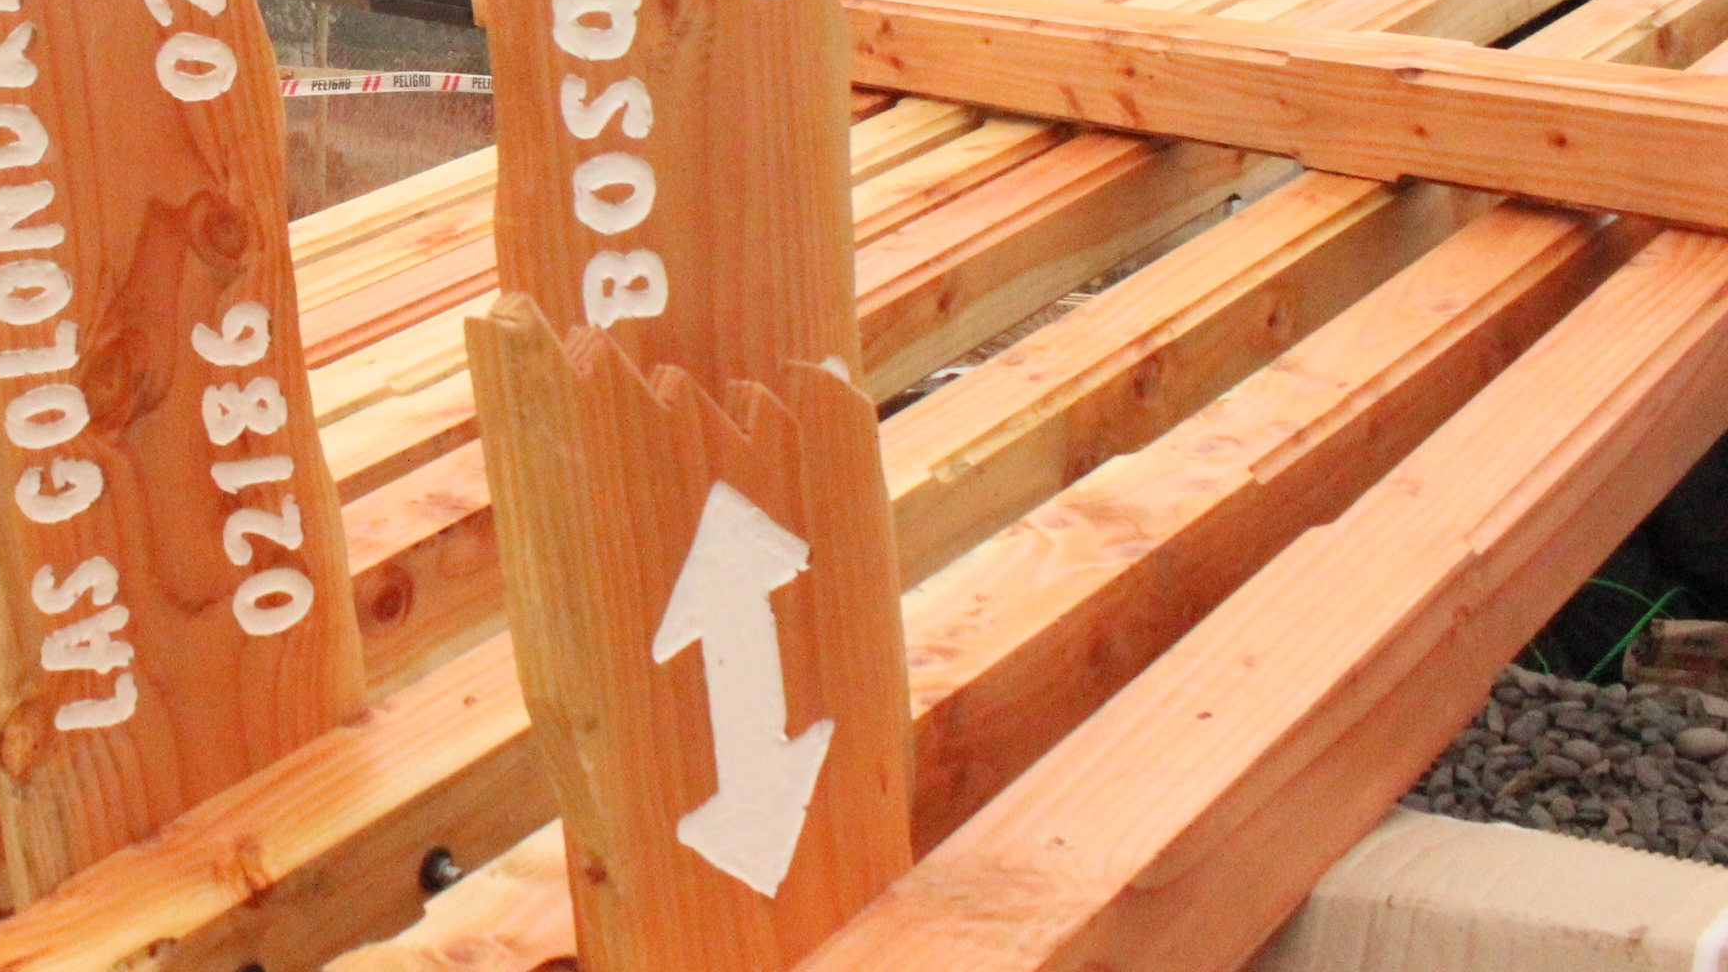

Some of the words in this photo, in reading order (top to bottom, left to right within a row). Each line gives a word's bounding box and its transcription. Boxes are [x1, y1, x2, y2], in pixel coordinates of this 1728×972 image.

[311, 78, 352, 92] PELIGRO
[393, 74, 431, 89] PELIGRO
[190, 300, 315, 637] 02186
[30, 555, 138, 731] LAS
